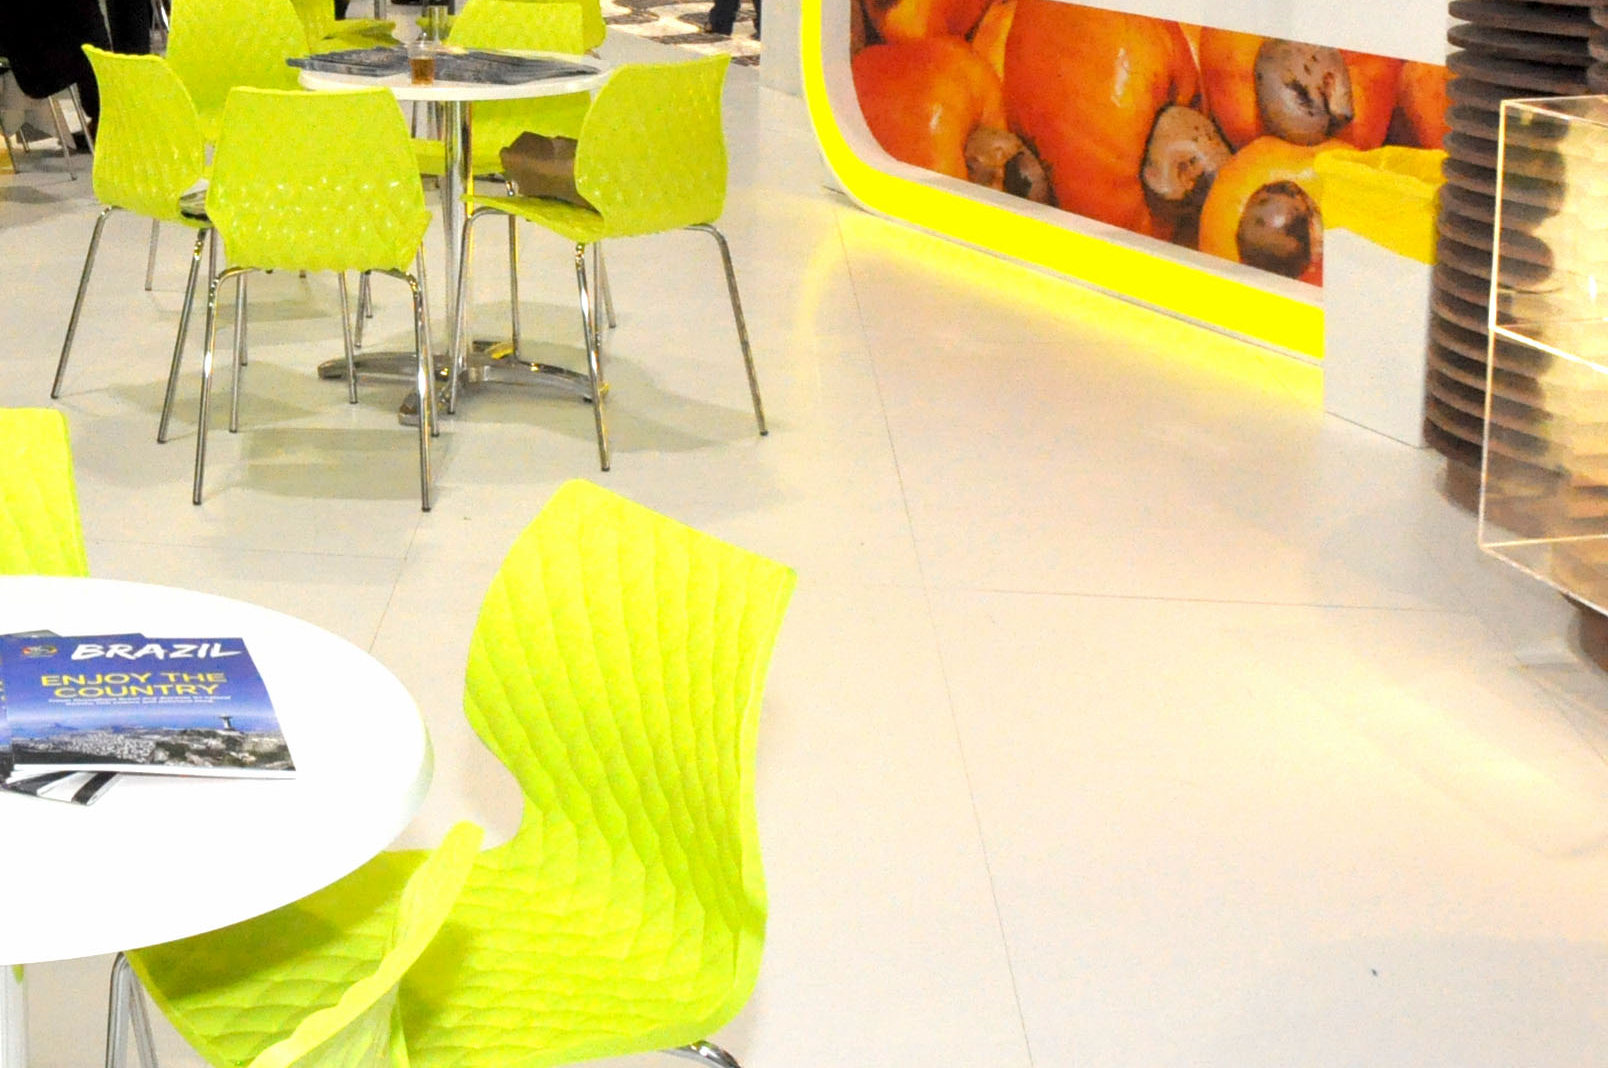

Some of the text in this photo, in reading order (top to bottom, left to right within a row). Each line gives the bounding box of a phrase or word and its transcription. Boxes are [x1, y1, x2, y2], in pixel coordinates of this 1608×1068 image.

[70, 643, 242, 661] BRAZIL
[41, 672, 228, 687] ENJOY THE
[53, 684, 220, 699] COUNTRY
